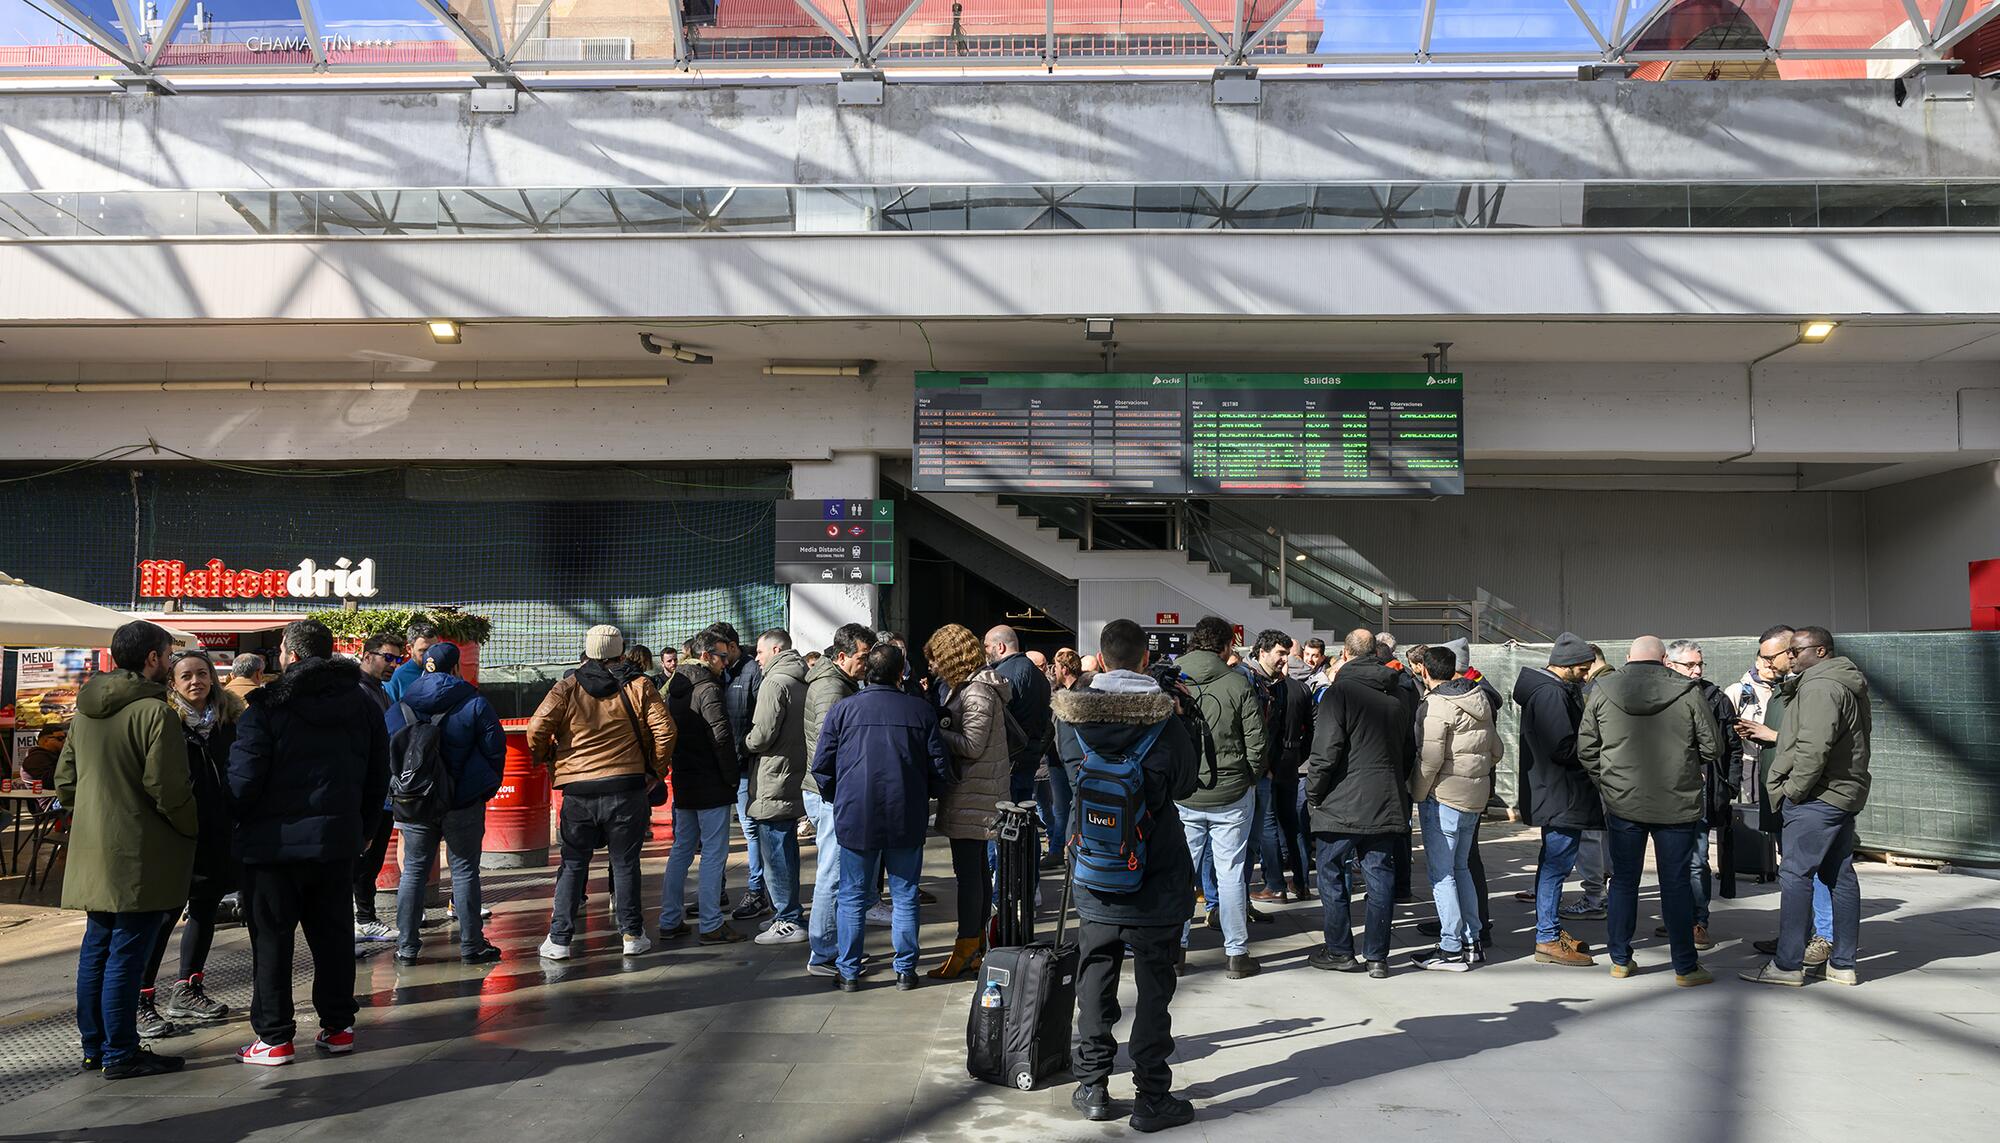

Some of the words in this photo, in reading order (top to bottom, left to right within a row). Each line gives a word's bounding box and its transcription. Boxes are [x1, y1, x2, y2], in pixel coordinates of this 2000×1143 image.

[246, 32, 352, 51] CHAMATÍN
[1303, 376, 1341, 385] salidas
[1437, 377, 1457, 385] adif
[21, 650, 53, 664] MENÚ
[17, 736, 39, 747] MEN
[1088, 813, 1115, 827] LiveU
